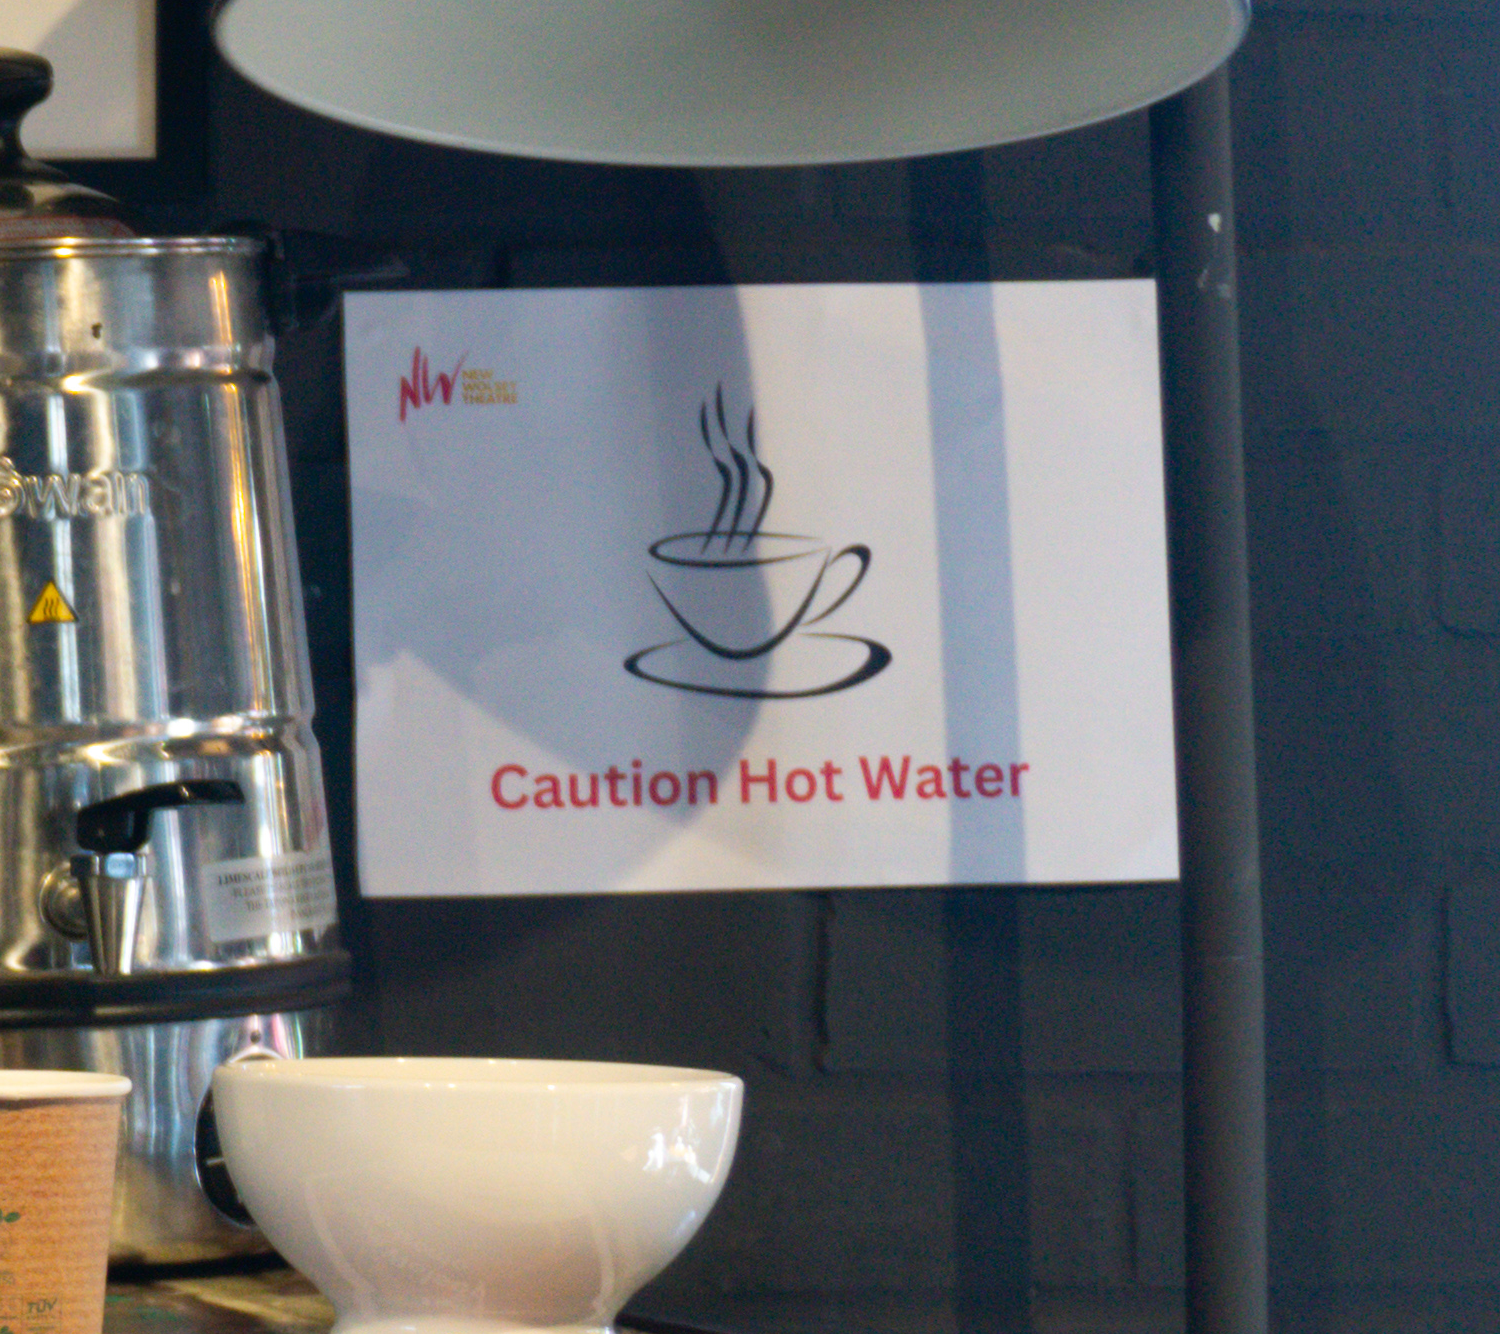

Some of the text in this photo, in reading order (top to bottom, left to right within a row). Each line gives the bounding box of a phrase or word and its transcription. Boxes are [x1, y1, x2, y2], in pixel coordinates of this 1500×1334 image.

[490, 755, 1030, 809] Caution Hot Water
